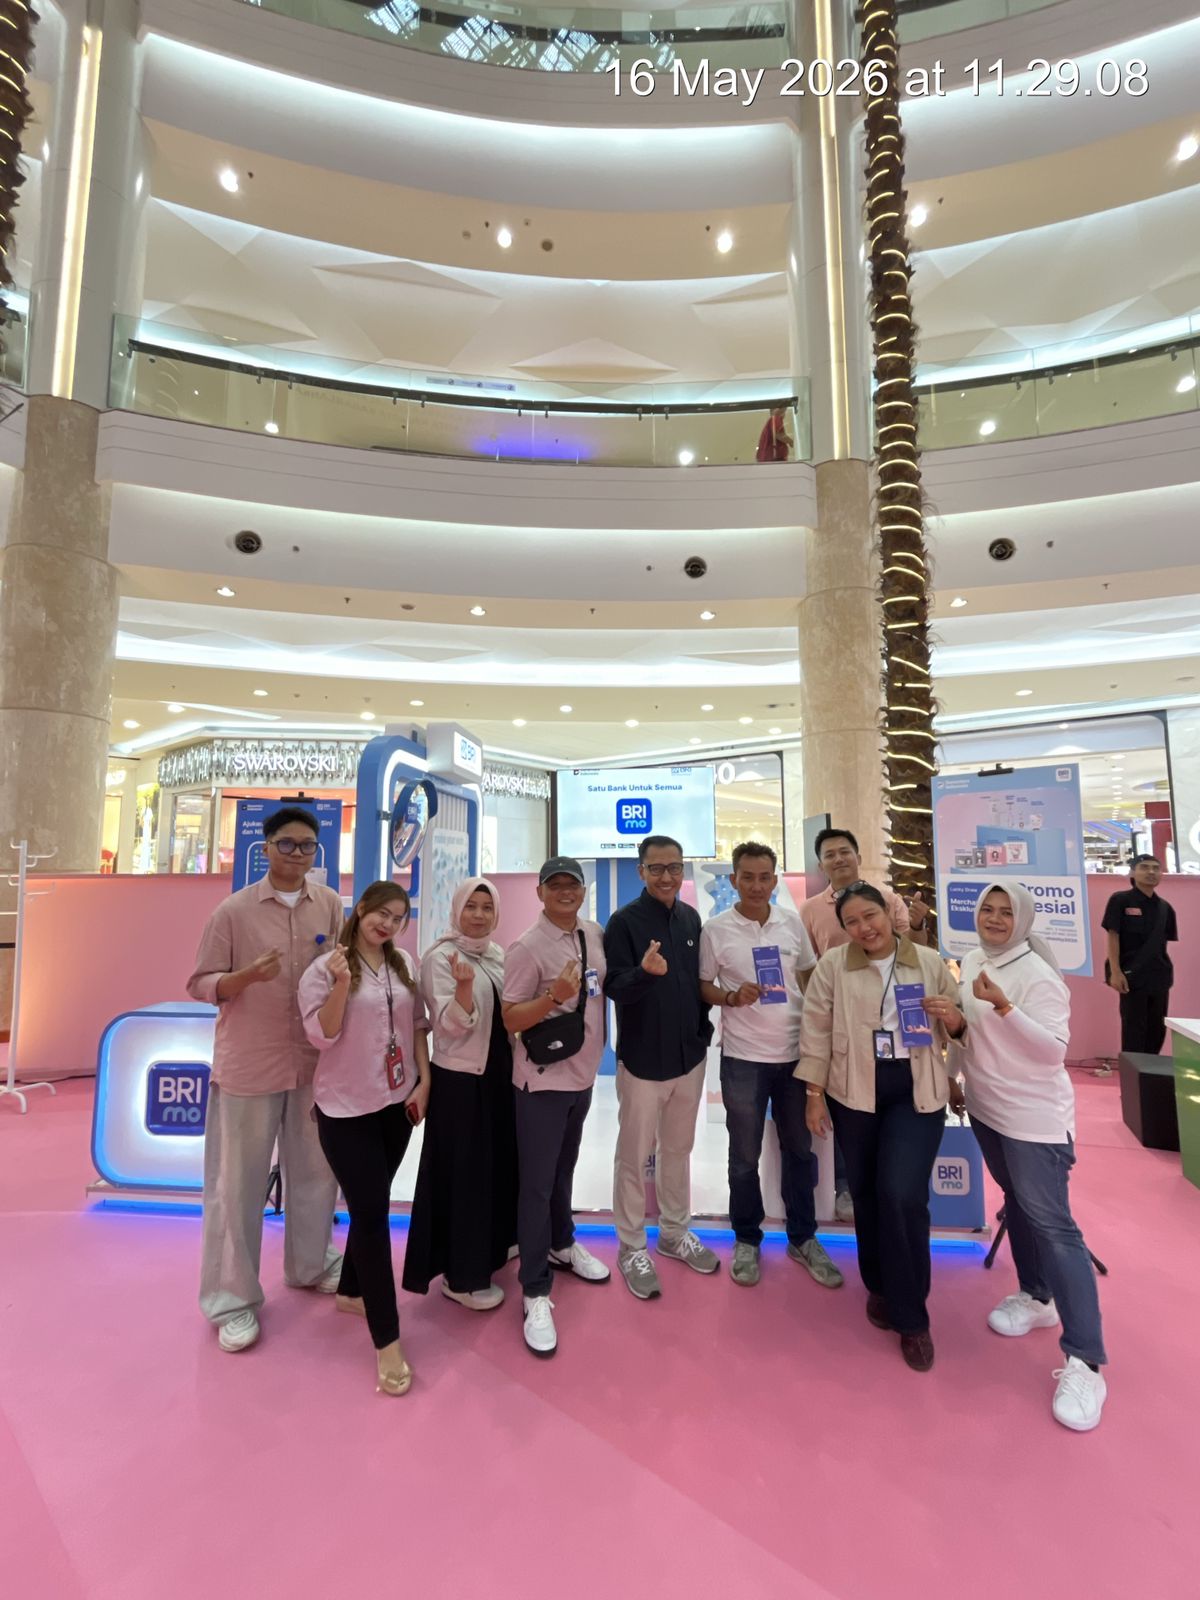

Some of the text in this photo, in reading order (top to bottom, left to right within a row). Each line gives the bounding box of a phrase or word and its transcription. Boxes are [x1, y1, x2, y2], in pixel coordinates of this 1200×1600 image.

[233, 754, 336, 771] SWAROVSKI
[482, 774, 529, 792] AROVSKI
[629, 784, 653, 792] Untuk
[621, 805, 647, 819] BRI
[625, 819, 647, 829] mo
[1018, 883, 1075, 899] romo
[950, 898, 977, 906] Mercha
[1034, 900, 1076, 915] esial
[158, 1076, 202, 1104] BRI
[162, 1106, 202, 1123] mo
[938, 1165, 962, 1180] BRI
[941, 1181, 963, 1189] mo
